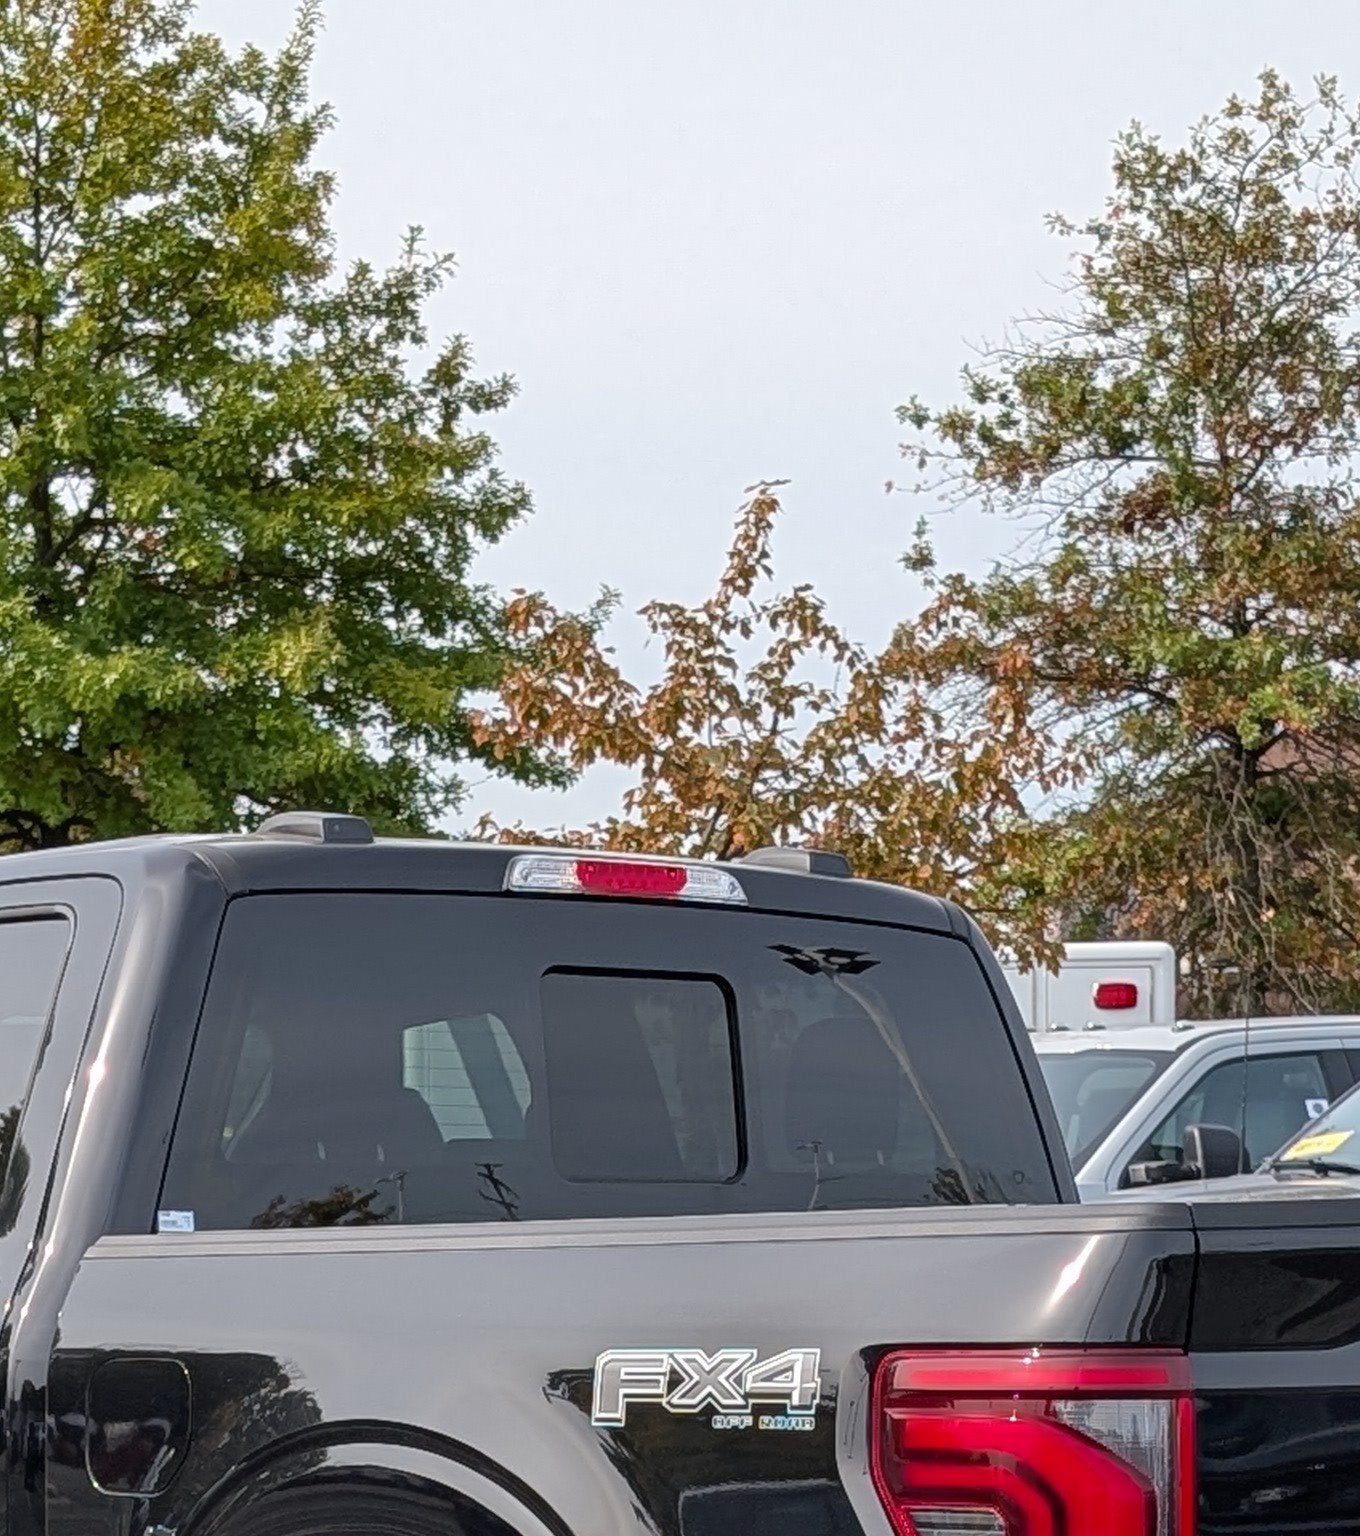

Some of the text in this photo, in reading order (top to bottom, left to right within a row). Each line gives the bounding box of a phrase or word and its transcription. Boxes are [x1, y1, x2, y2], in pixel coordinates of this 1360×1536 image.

[592, 1348, 820, 1427] FX4
[712, 1415, 816, 1431] OFF ROAD
